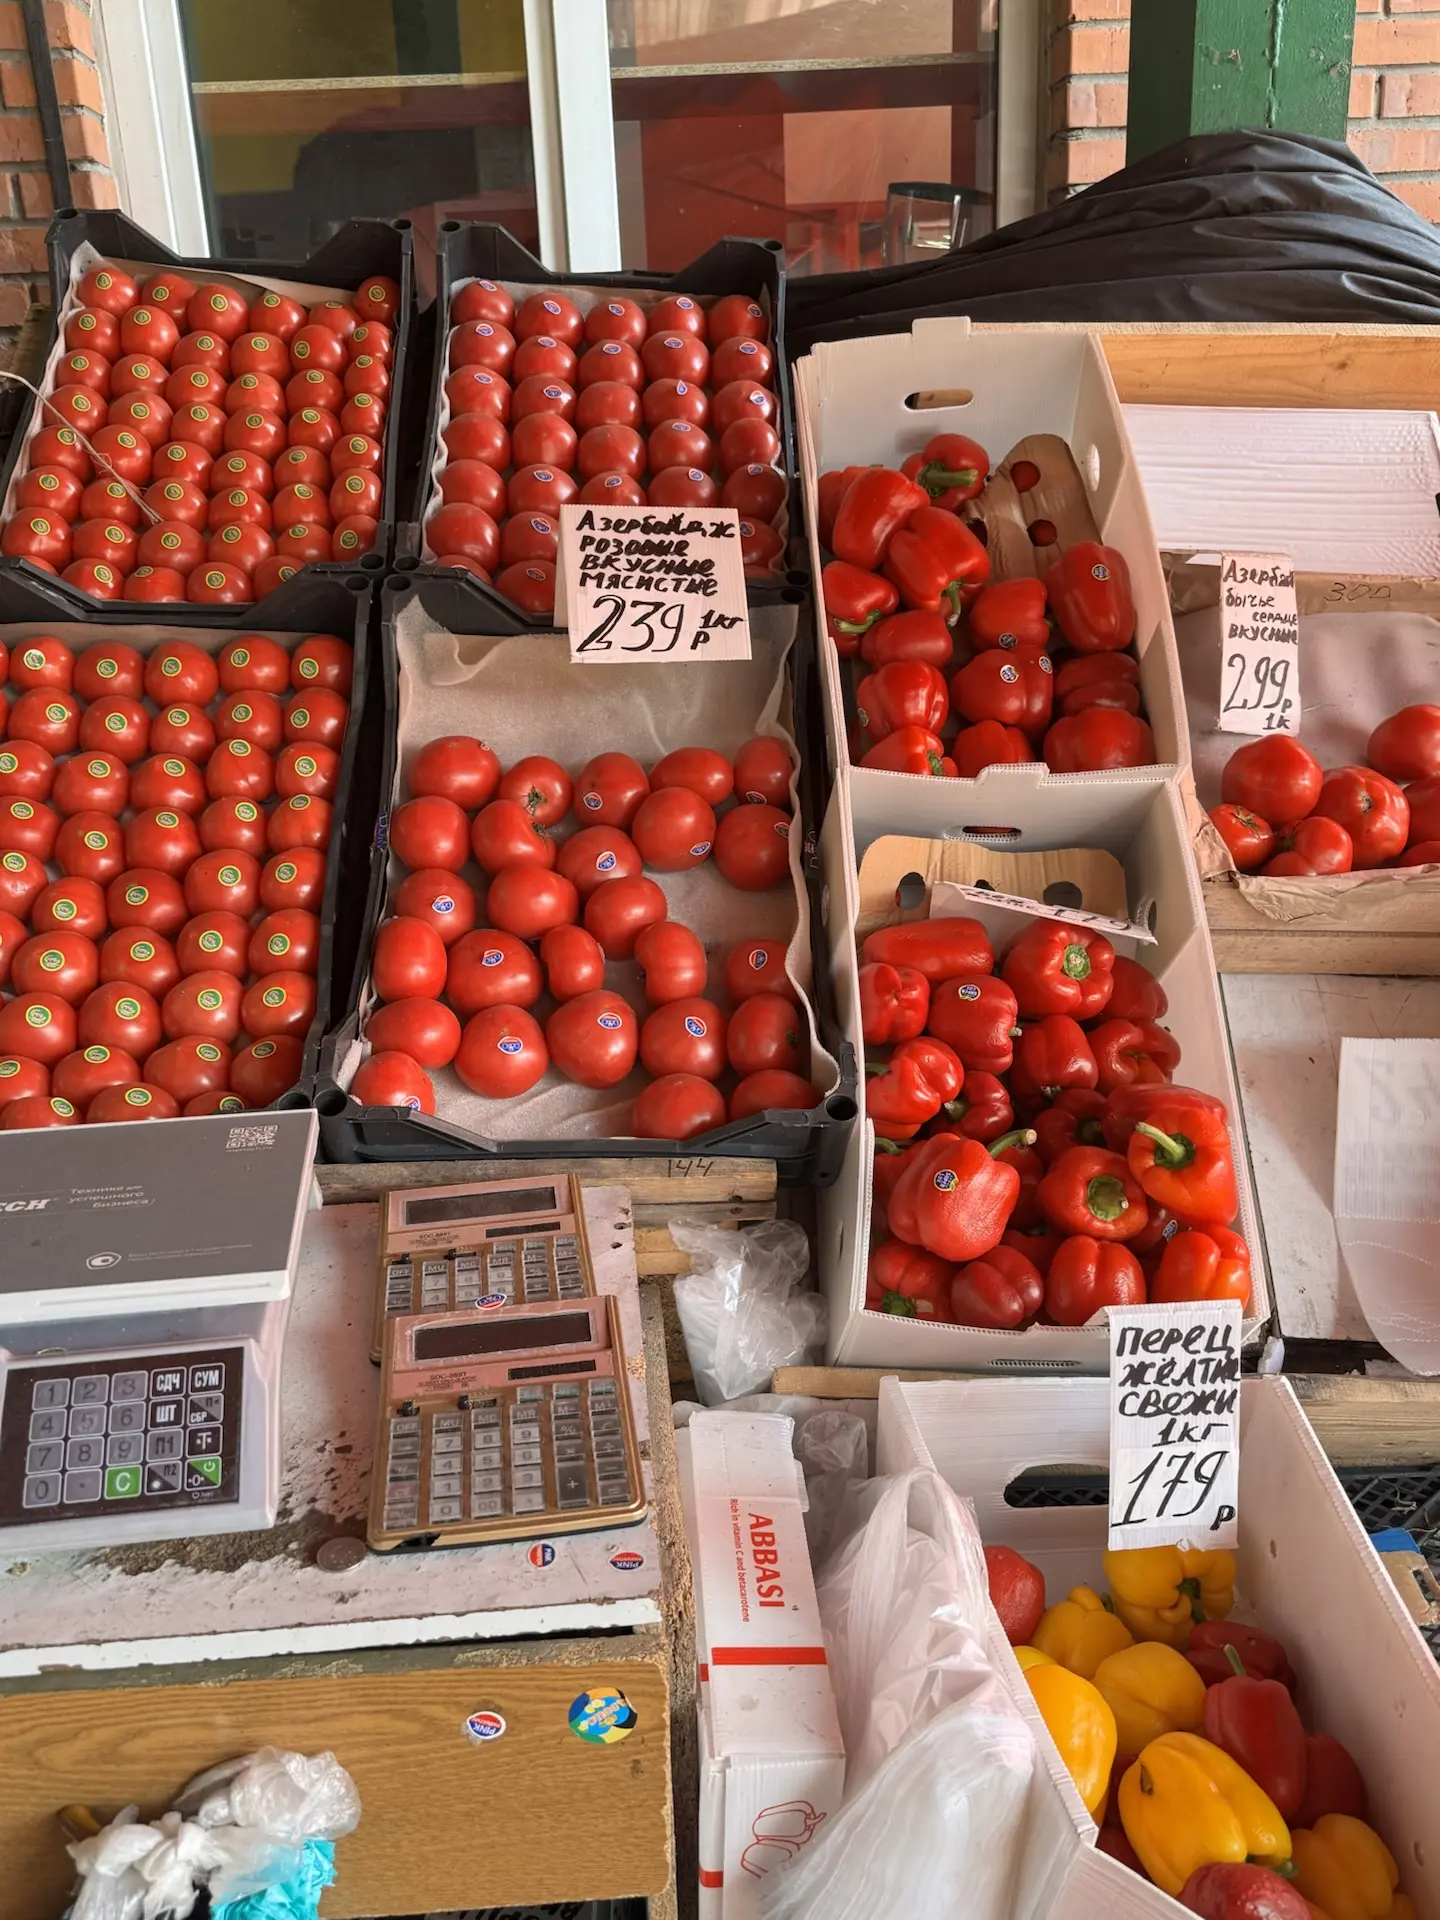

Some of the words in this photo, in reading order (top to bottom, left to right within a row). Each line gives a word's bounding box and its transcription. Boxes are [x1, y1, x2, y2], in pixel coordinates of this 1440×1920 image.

[576, 594, 685, 652] 239
[1223, 653, 1290, 712] 299
[122, 1378, 136, 1396] 3
[156, 1372, 181, 1392] СДЧ
[194, 1369, 220, 1388] СУМ
[82, 1381, 97, 1400] 2
[81, 1411, 94, 1430] 5
[121, 1408, 134, 1427] 6
[156, 1404, 177, 1423] ШТ
[190, 1411, 208, 1423] СБР
[41, 1416, 54, 1433] 4
[78, 1443, 92, 1462] 8
[118, 1440, 132, 1459] 9
[155, 1435, 174, 1455] П1
[38, 1447, 52, 1467] 7
[442, 1460, 452, 1470] 4
[35, 1480, 49, 1499] 0
[1110, 1451, 1230, 1528] 179
[730, 1498, 740, 1513] Rich
[732, 1513, 741, 1521] in
[733, 1522, 743, 1549] vitamin
[737, 1556, 747, 1571] and
[748, 1512, 785, 1607] ABBASI
[738, 1571, 750, 1623] betacarotene
[473, 1722, 497, 1735] PINK
